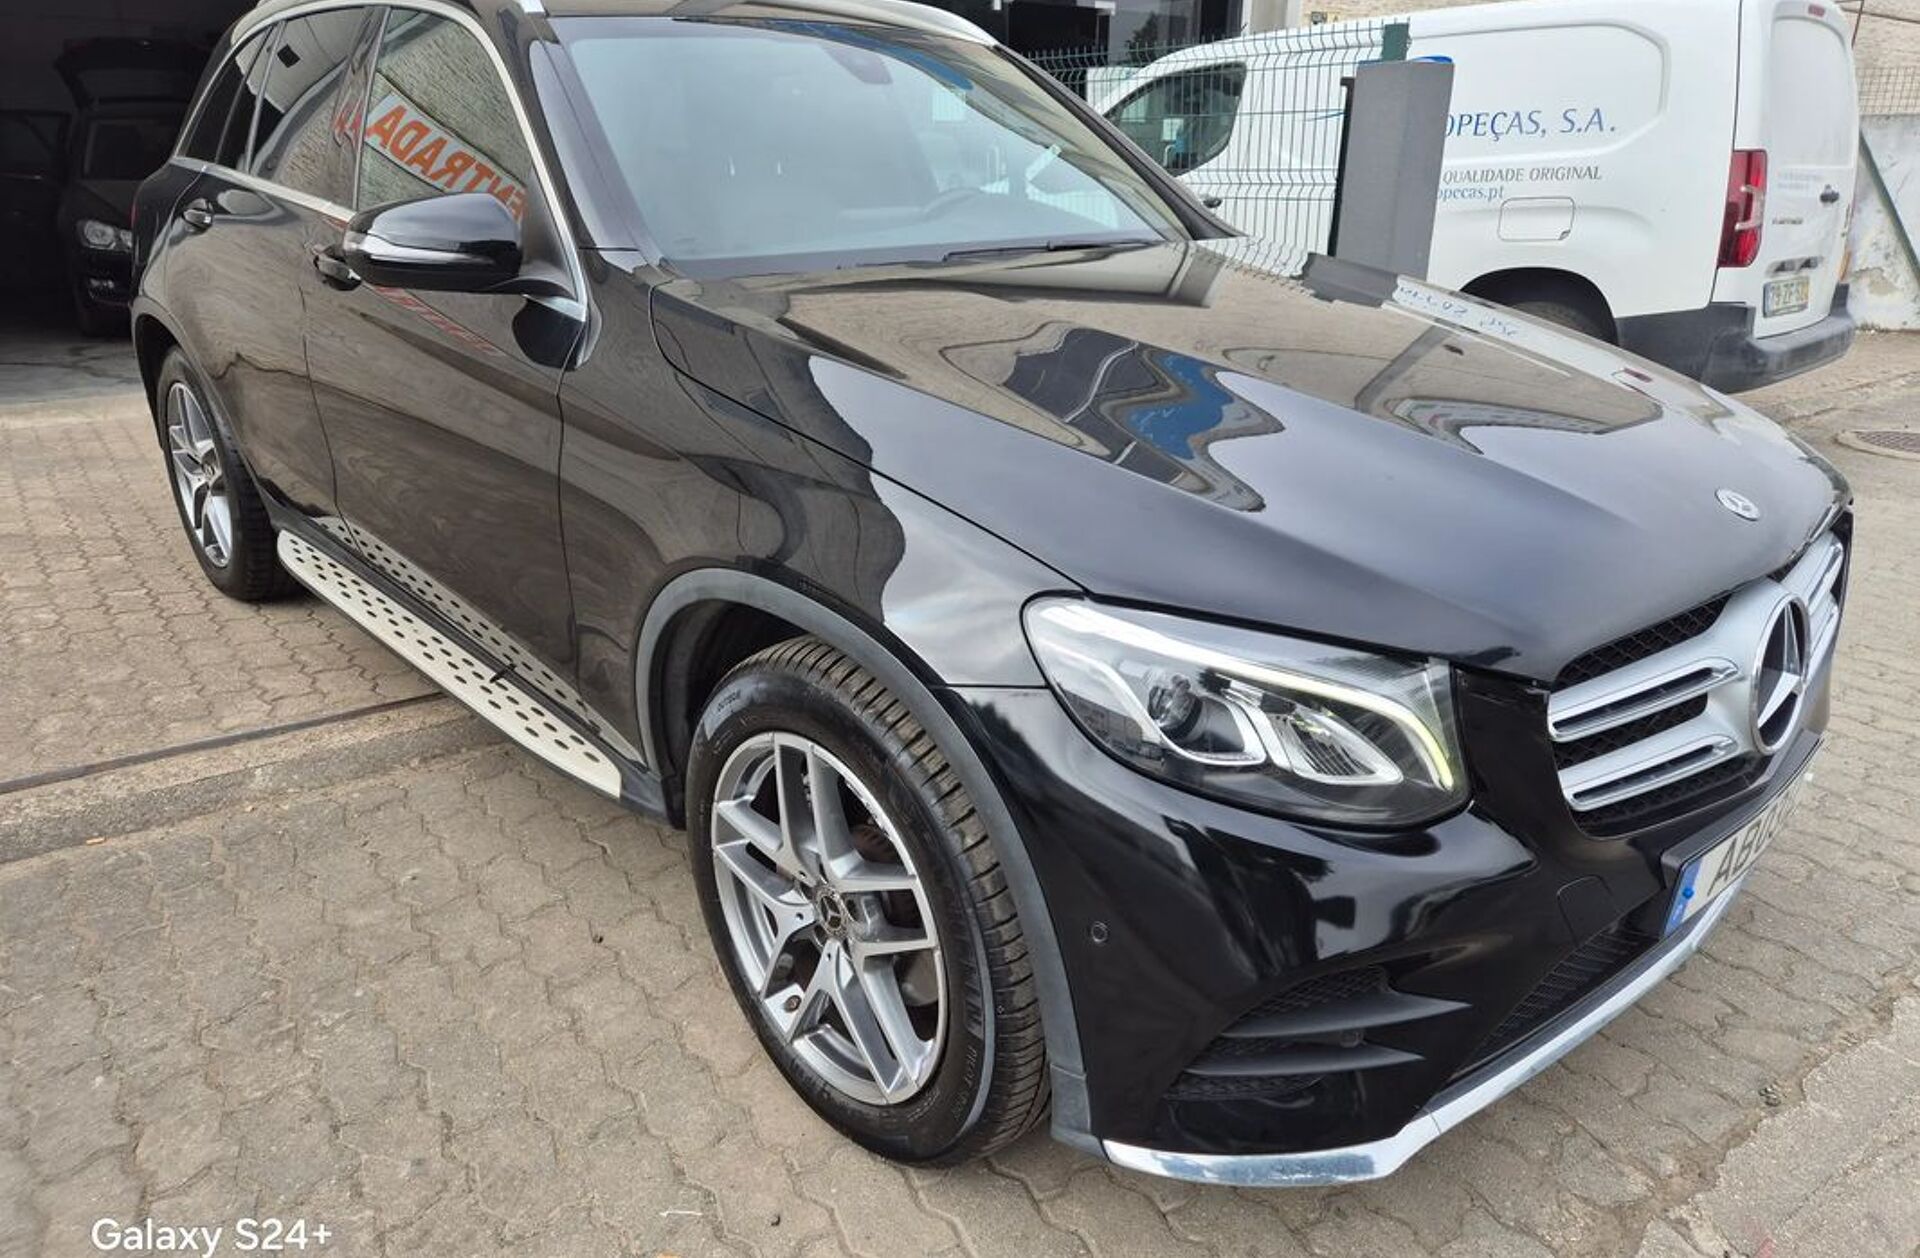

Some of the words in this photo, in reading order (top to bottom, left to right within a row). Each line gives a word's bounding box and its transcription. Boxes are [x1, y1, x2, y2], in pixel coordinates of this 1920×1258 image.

[1559, 108, 1616, 133] S.A.
[1442, 167, 1525, 185] QUALIDADE
[1529, 165, 1602, 181] ORIGINAL
